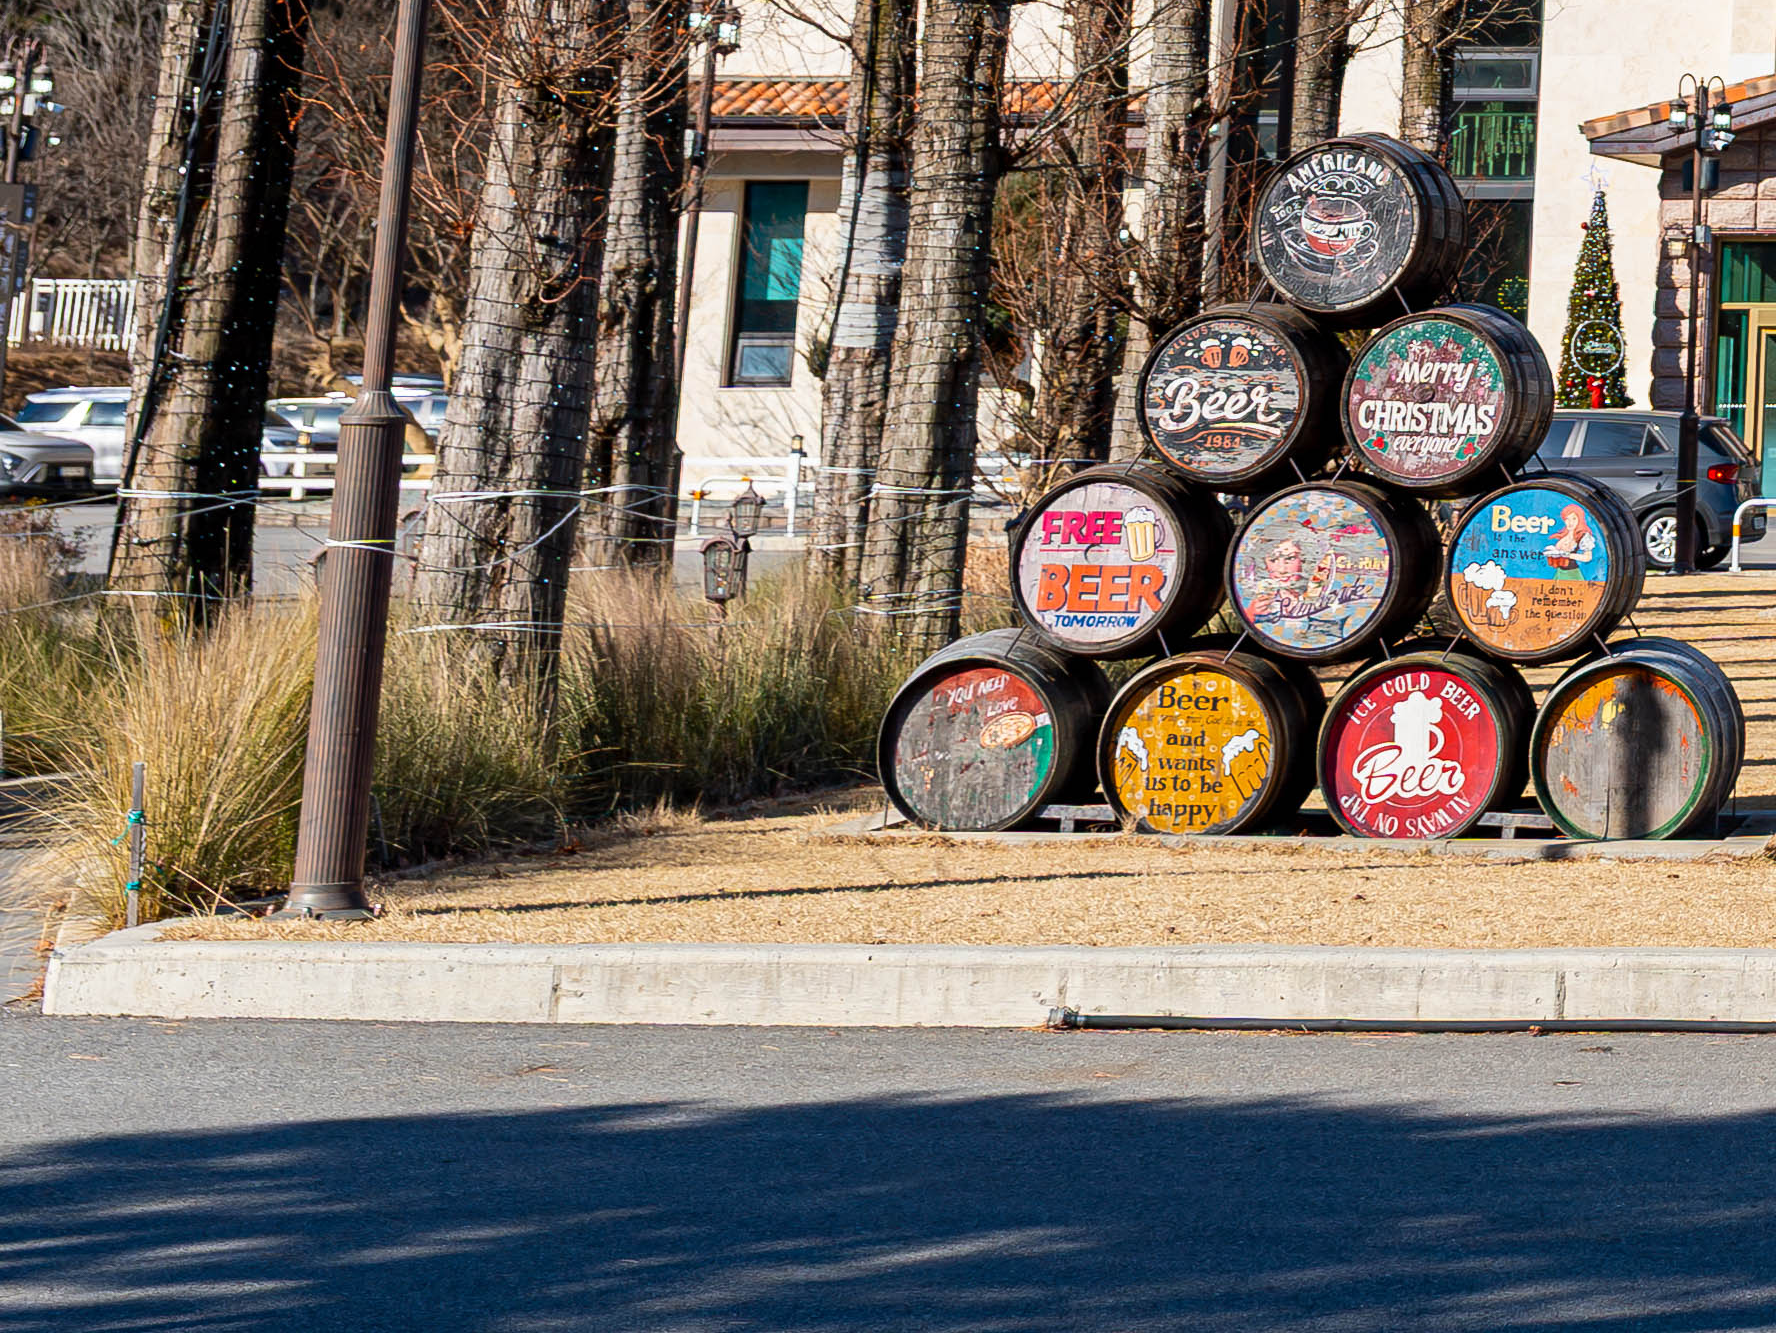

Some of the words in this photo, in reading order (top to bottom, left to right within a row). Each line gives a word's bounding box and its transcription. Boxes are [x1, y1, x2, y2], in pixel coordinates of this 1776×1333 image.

[1396, 361, 1475, 393] Merry
[1159, 378, 1281, 432] Beer
[1358, 399, 1496, 436] CHRISTMAS
[1040, 511, 1124, 545] FREE
[1491, 505, 1556, 535] Beer
[1509, 533, 1526, 543] the
[1036, 564, 1168, 613] BEER
[1532, 596, 1584, 608] remember
[1054, 614, 1140, 628] TOMORROW
[1525, 608, 1541, 619] the
[1545, 609, 1587, 622] question
[947, 684, 974, 707] YOU
[1158, 685, 1229, 712] Beer
[1347, 694, 1378, 725] ICE
[1382, 673, 1431, 697] COLD
[1440, 680, 1481, 721] BEER
[1166, 730, 1206, 747] and
[1158, 757, 1217, 772] wants
[1354, 743, 1463, 802] Beer
[1145, 776, 1167, 791] us
[1172, 774, 1192, 792] to
[1200, 775, 1224, 794] be
[1149, 798, 1218, 827] happy
[1340, 793, 1373, 824] TAP
[1373, 812, 1399, 836] ON
